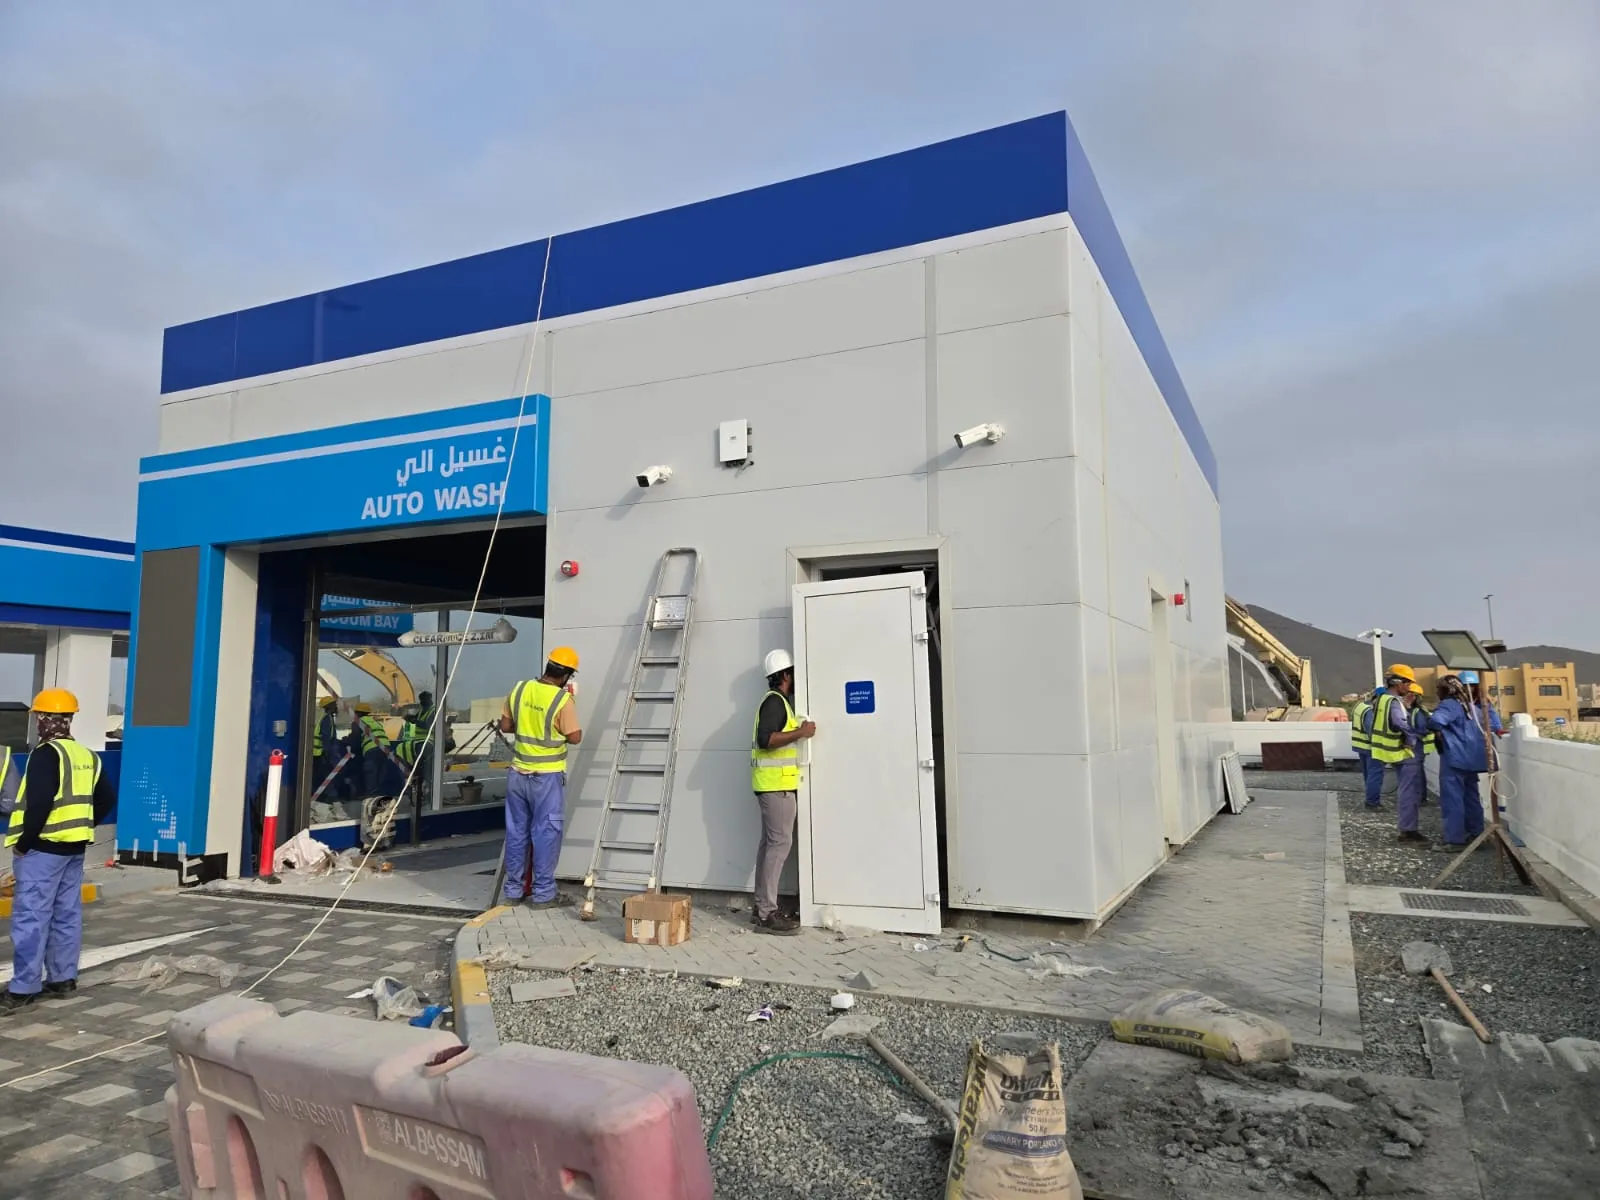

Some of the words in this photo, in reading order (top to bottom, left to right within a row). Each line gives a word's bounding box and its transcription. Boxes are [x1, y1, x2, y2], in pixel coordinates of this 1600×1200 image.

[396, 448, 434, 487] الي
[440, 436, 507, 478] غسيل
[361, 491, 424, 520] AUTO
[434, 481, 507, 512] WASH
[373, 614, 400, 629] BAY
[393, 1117, 416, 1152] AL
[414, 1124, 487, 1180] BASSAM
